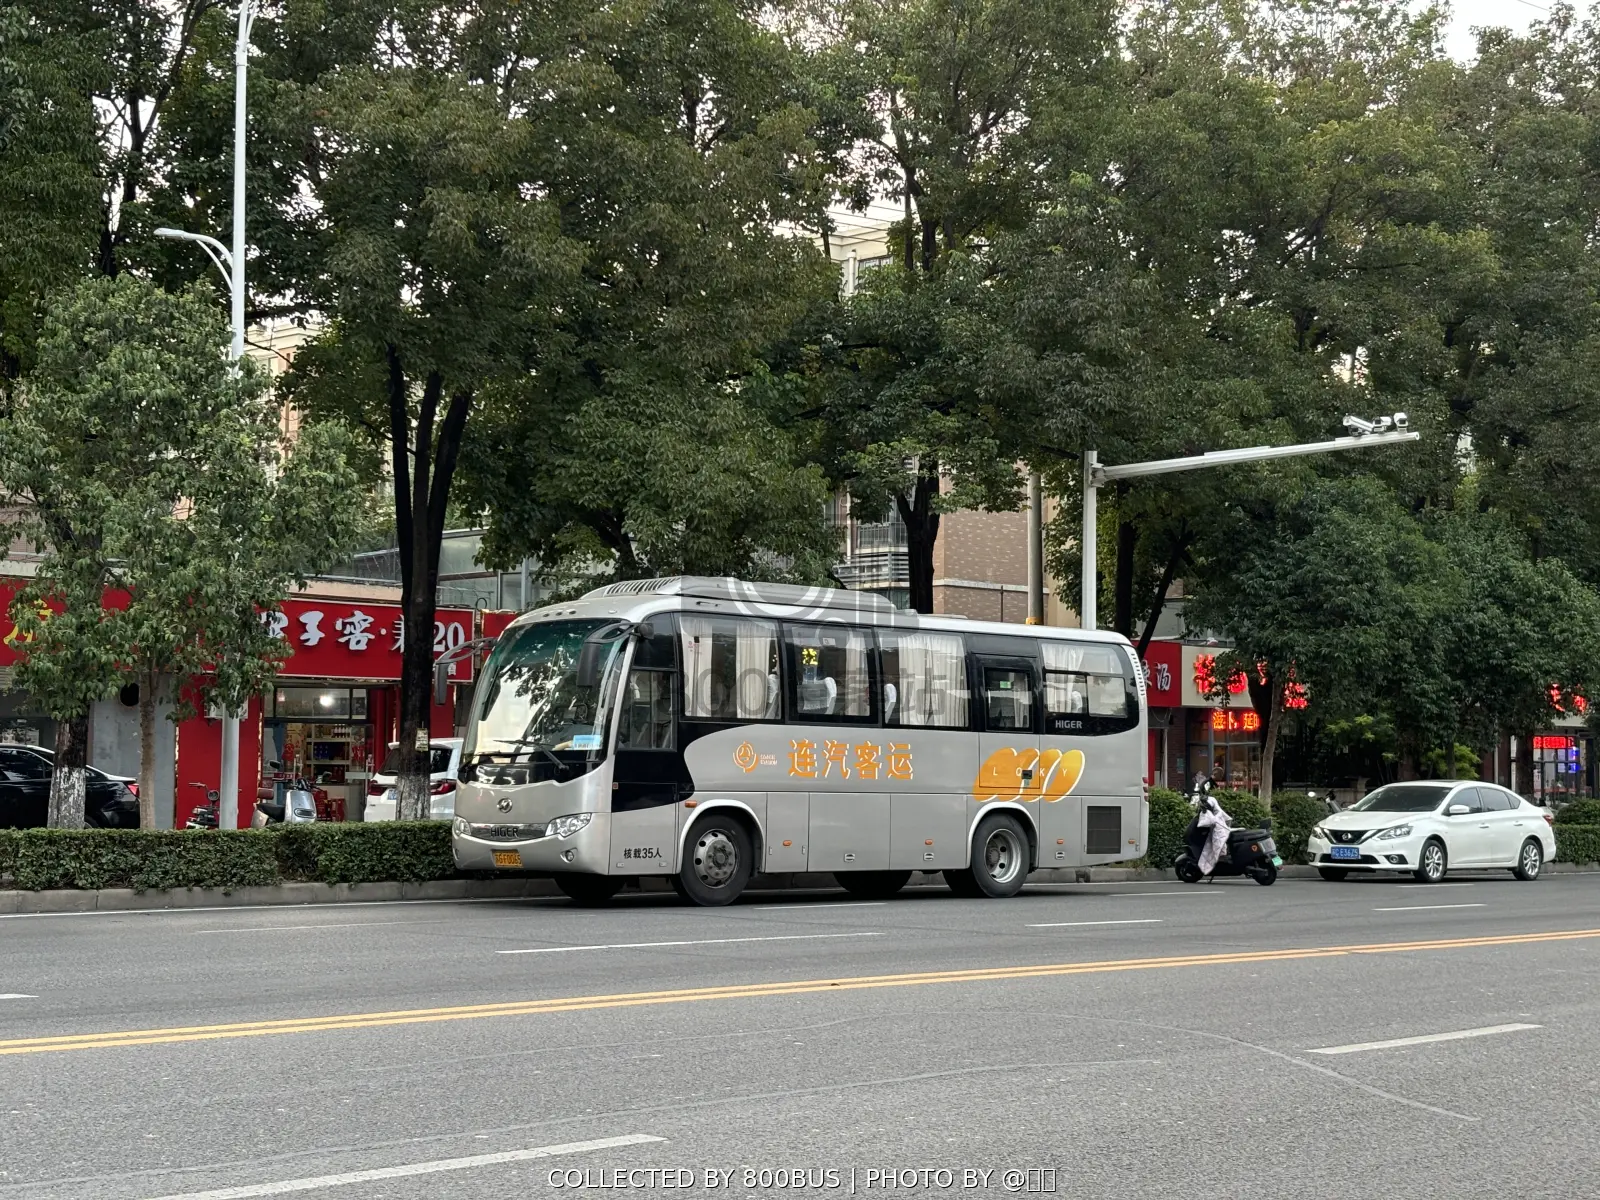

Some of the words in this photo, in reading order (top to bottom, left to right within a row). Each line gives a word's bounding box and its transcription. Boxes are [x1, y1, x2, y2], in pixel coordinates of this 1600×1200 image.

[1055, 719, 1083, 729] HIGER
[787, 739, 914, 780] 连汽客运
[490, 826, 519, 838] HIGER
[623, 847, 662, 859] 核载35人
